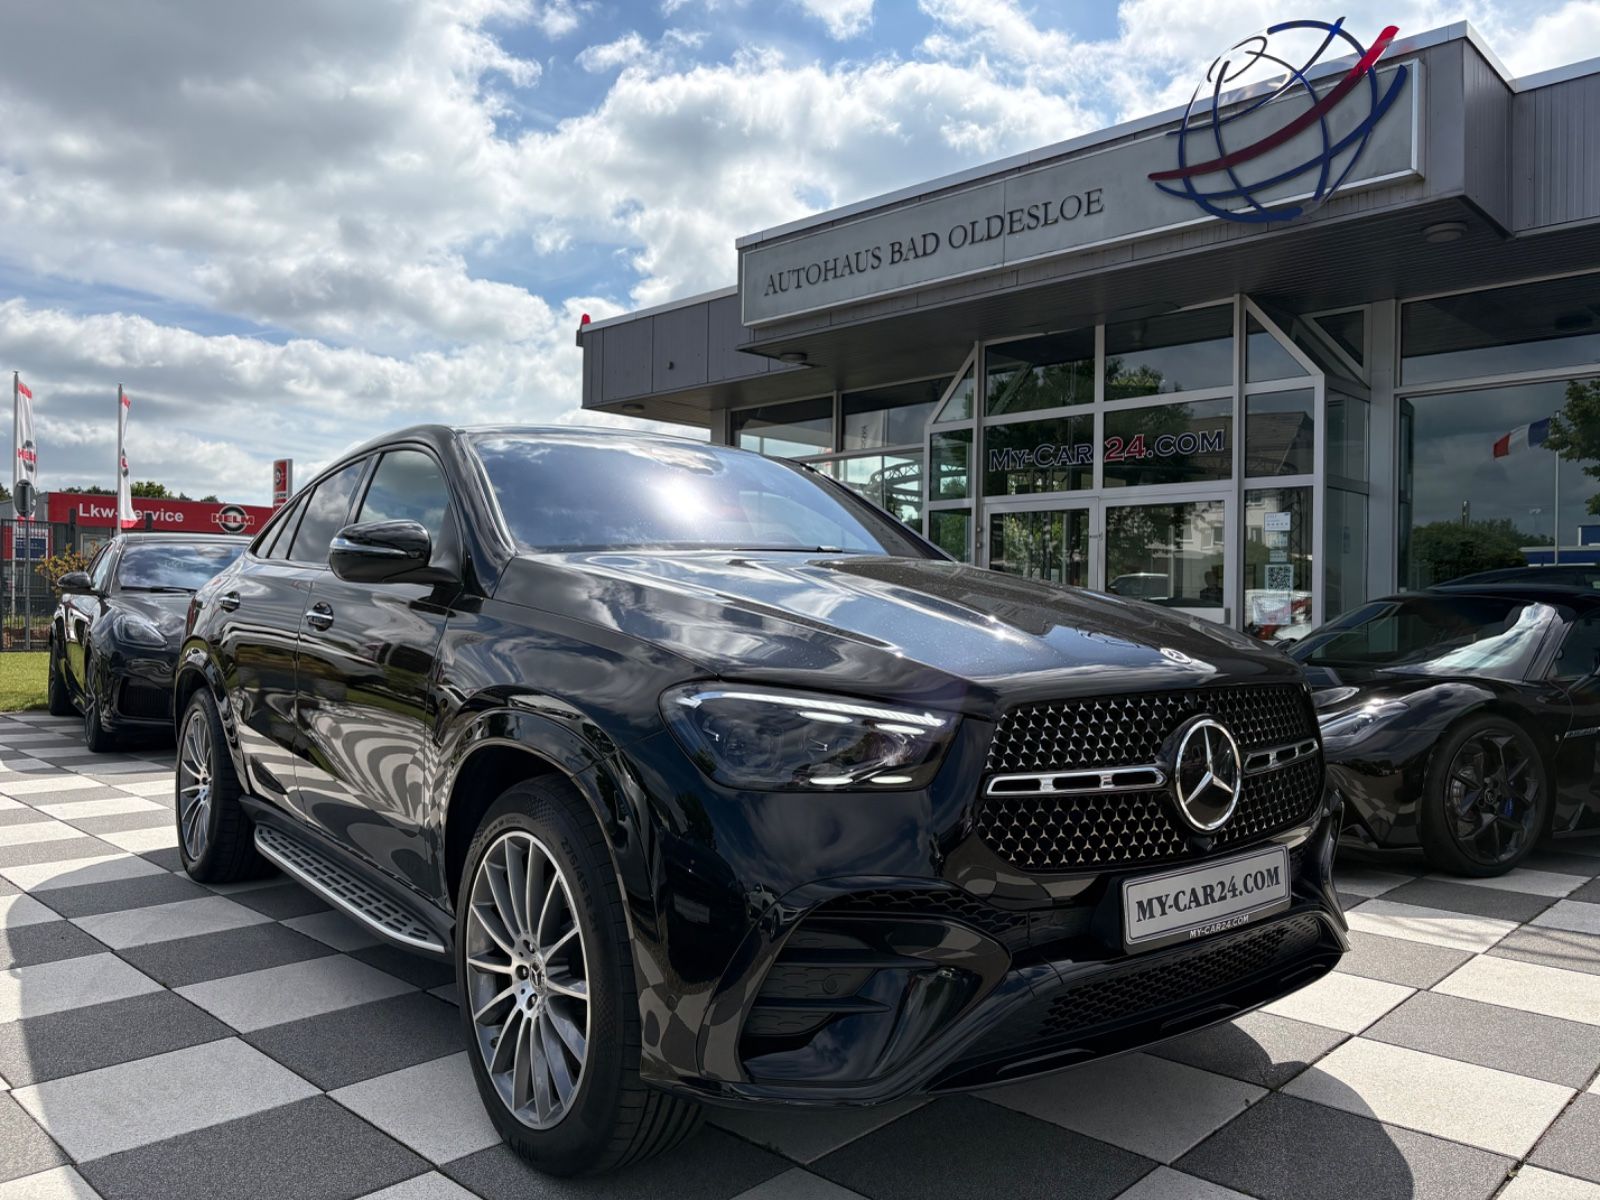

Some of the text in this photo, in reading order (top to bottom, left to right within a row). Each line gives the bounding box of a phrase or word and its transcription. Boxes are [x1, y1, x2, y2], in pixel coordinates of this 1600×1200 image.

[764, 188, 1105, 297] AUTOHAUS BAD OLDESLOE
[79, 502, 184, 522] Lkw-ervice
[211, 513, 255, 526] HELM
[1136, 866, 1281, 923] MY-CAR24.COM
[1189, 913, 1250, 939] MY-CAR24.COM
